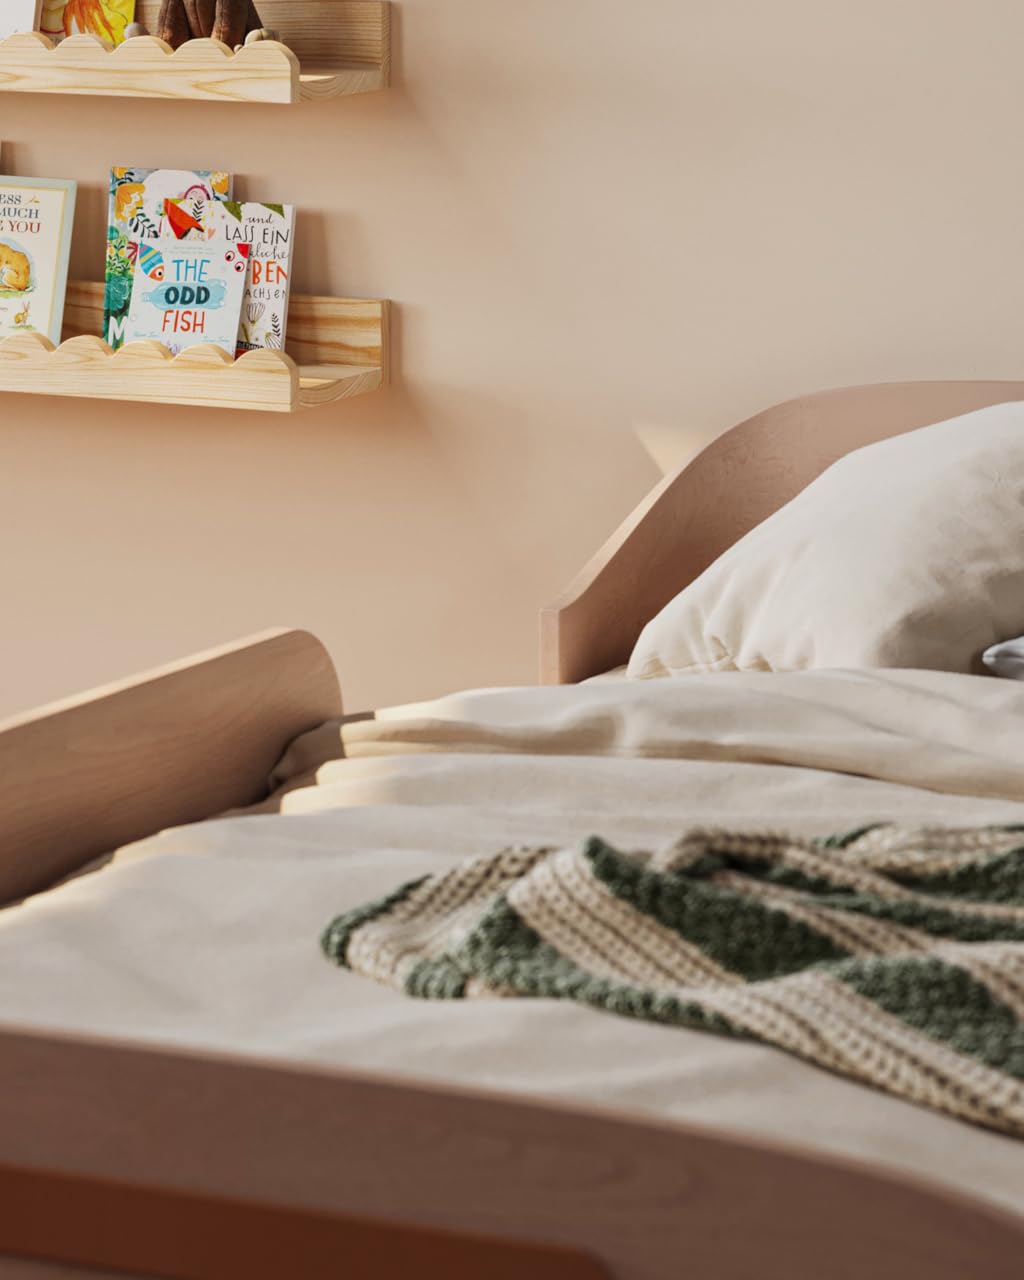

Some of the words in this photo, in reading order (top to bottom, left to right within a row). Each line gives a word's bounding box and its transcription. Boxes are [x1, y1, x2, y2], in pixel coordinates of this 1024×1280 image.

[8, 220, 43, 234] YOU
[247, 213, 275, 224] und
[225, 224, 255, 243] LASS
[171, 258, 211, 282] THE
[164, 286, 211, 306] ODD
[162, 309, 206, 334] FISH
